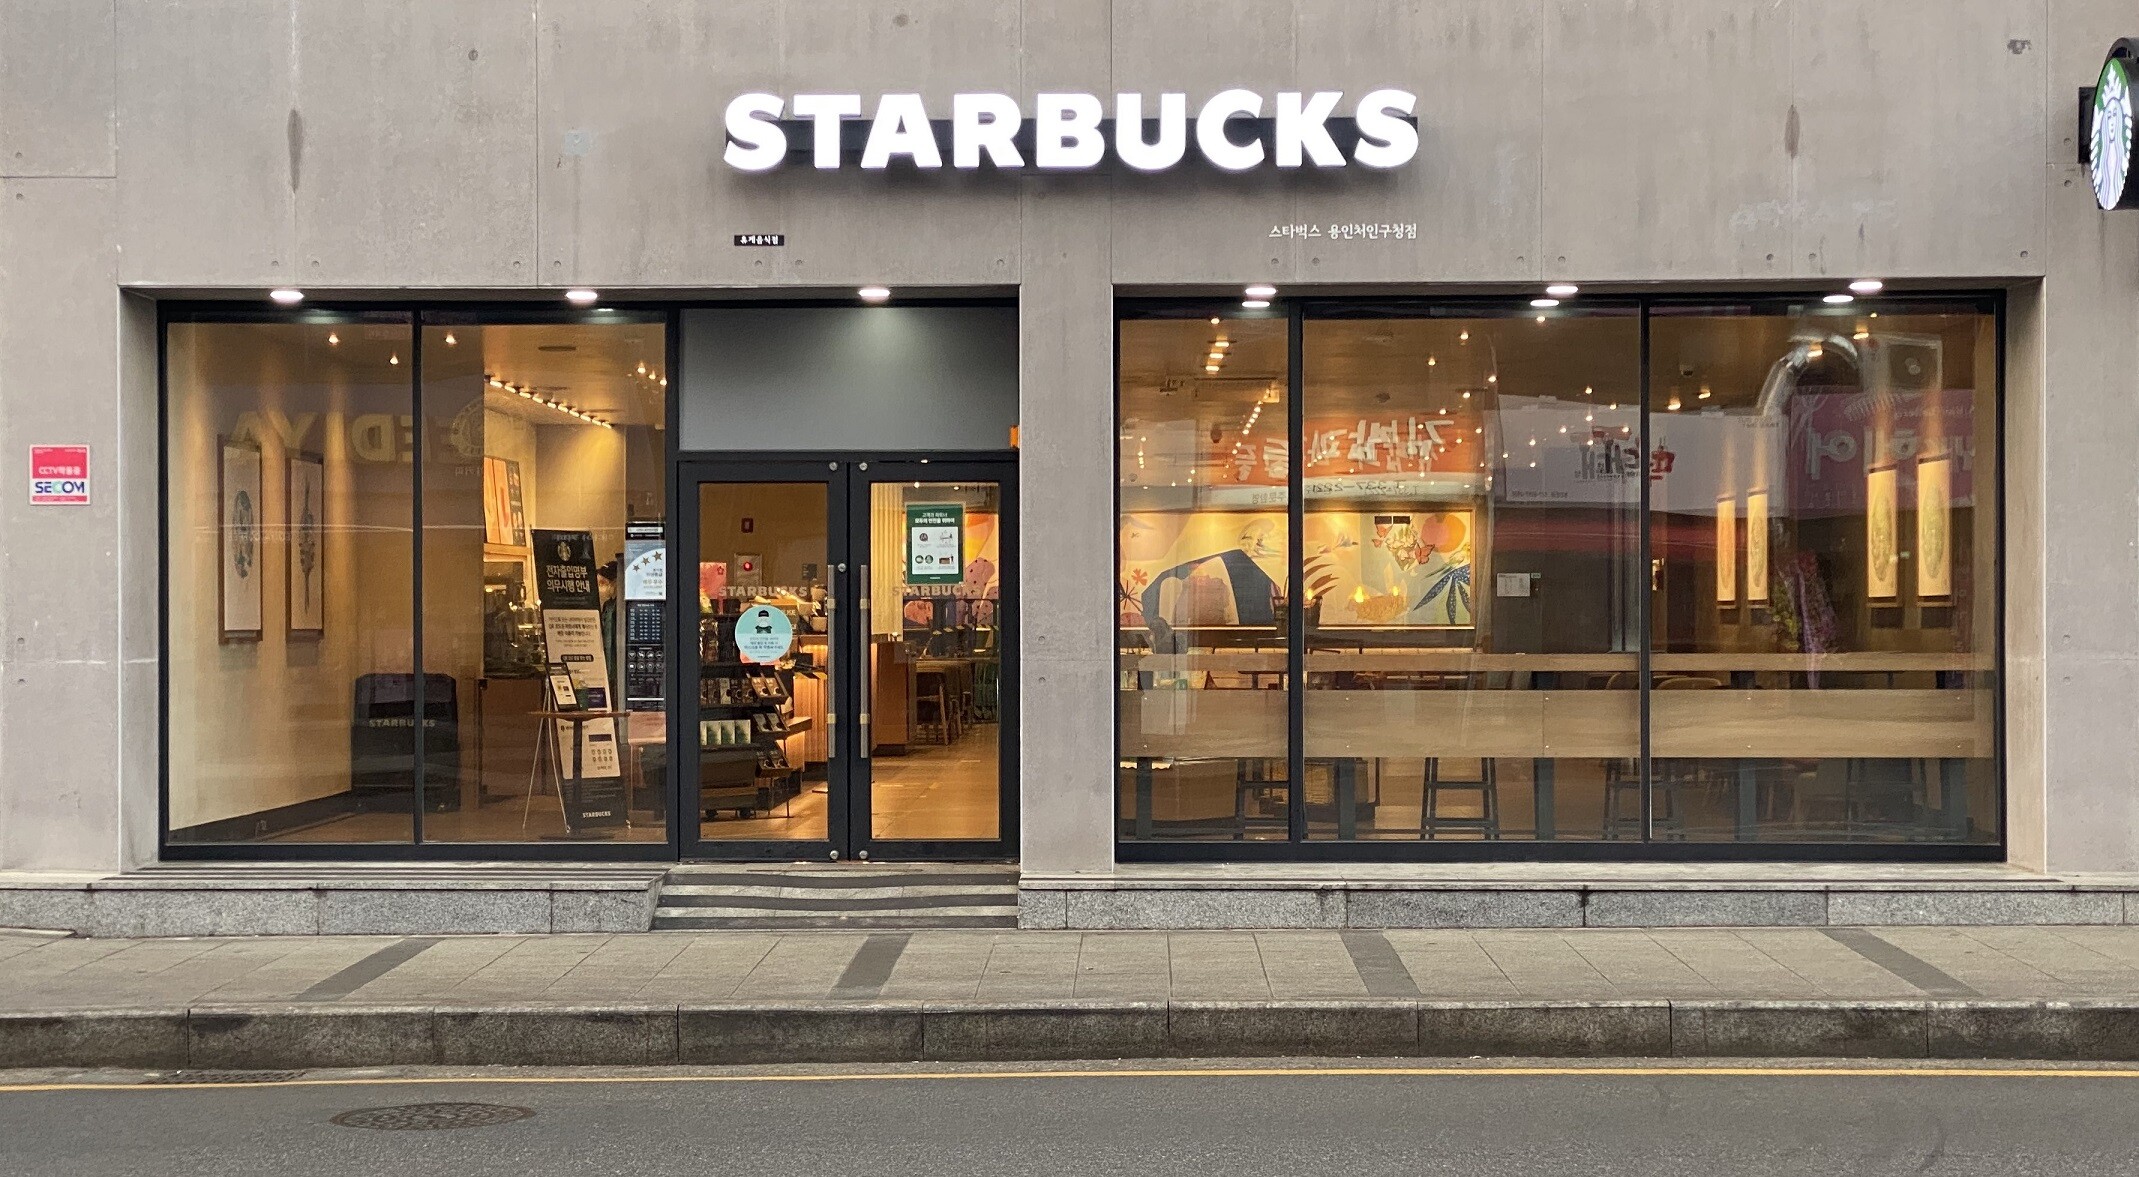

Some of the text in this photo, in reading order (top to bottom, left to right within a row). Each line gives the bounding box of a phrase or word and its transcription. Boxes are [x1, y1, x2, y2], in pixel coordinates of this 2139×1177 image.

[723, 89, 1419, 171] STARBUCKS
[1269, 223, 1417, 240] 스타벅스 용인처인구청점
[35, 481, 85, 493] SECOM
[546, 564, 588, 579] 전자출입명부
[546, 579, 591, 593] 의무시행 안내
[719, 586, 807, 597] STARBUCKS
[369, 719, 435, 727] STARBUKS
[582, 810, 611, 818] STARBUCKS
